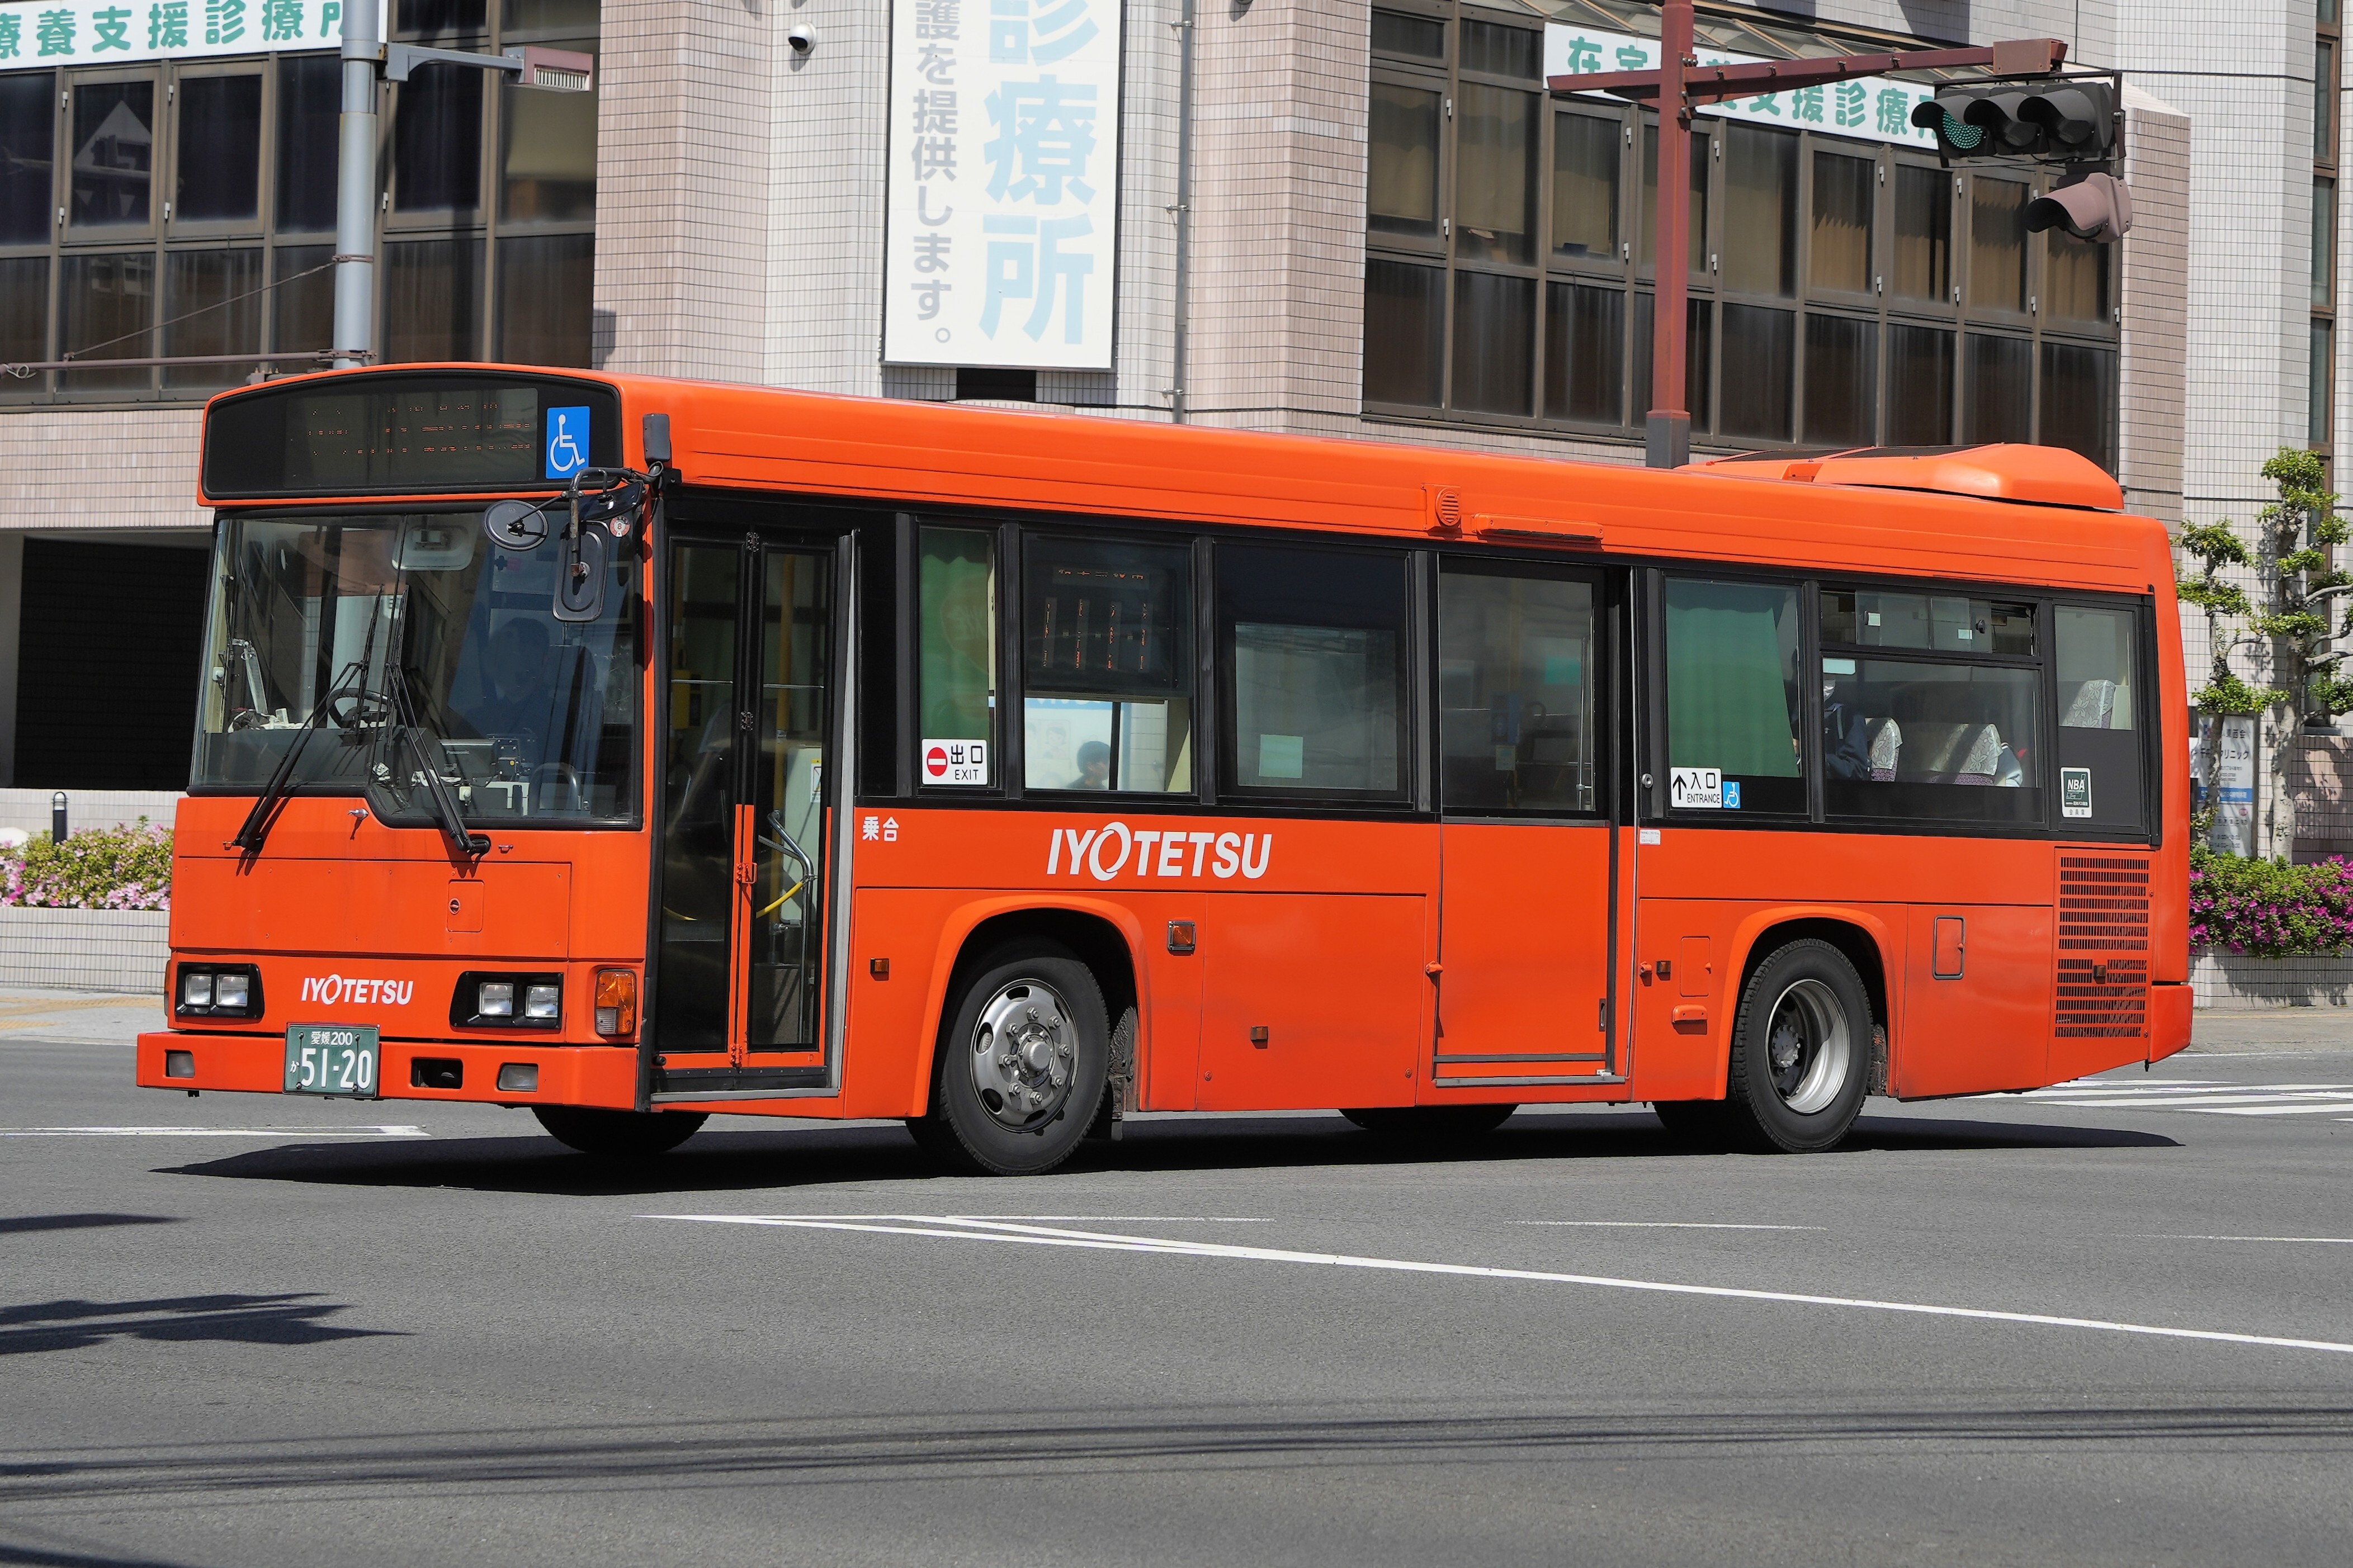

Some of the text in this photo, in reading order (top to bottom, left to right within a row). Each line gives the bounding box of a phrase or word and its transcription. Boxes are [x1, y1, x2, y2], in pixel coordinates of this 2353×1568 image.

[951, 744, 983, 765] 出口
[955, 769, 979, 780] EXIT
[1690, 772, 1716, 789] 入口
[2067, 779, 2085, 790] NBA
[1687, 793, 1721, 803] ENTRANCE
[862, 816, 900, 842] 乗合
[1046, 821, 1273, 882] IYOTETSU
[301, 974, 414, 1005] IYOTETSU
[301, 1048, 372, 1089] 51-20
